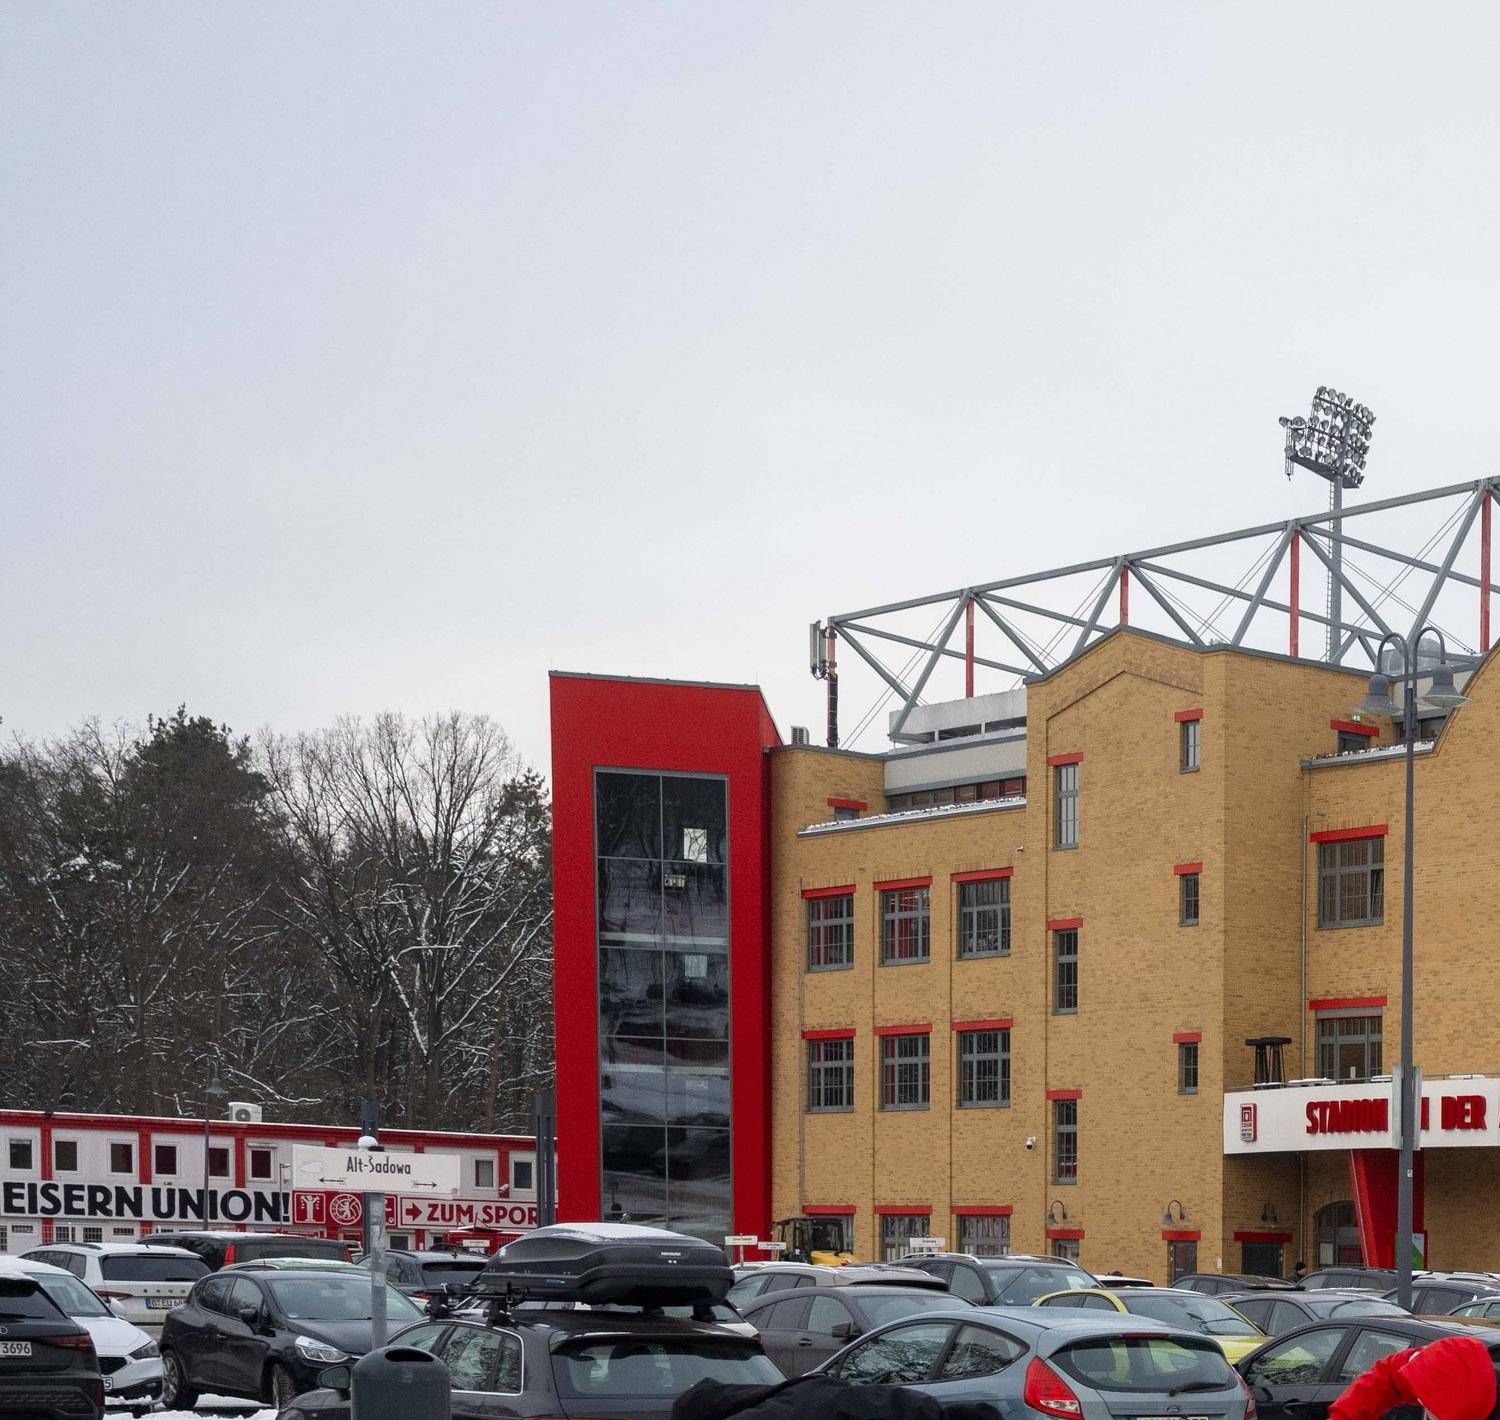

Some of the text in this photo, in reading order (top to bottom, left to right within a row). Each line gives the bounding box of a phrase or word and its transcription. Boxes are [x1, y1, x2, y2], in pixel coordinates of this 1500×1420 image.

[1306, 1098, 1389, 1135] STADION
[1441, 1095, 1487, 1131] DER
[346, 1155, 411, 1175] Alt-Sadowa
[3, 1182, 291, 1222] EISERN UNION!
[427, 1203, 474, 1224] ZUM
